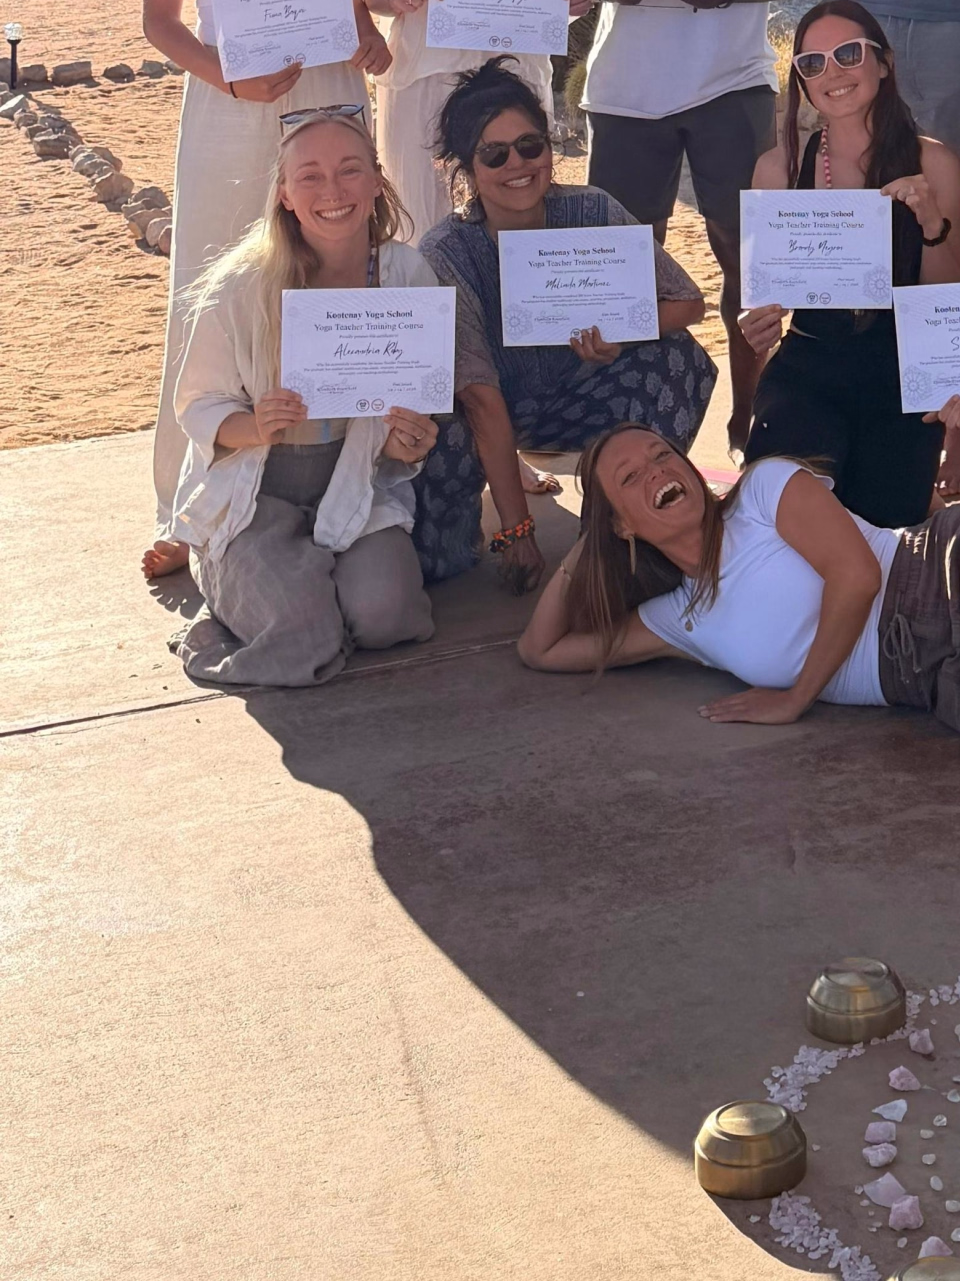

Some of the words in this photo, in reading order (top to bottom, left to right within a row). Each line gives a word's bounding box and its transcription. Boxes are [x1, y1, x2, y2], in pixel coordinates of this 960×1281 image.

[778, 211, 809, 219] Kootenay
[326, 311, 362, 320] Kootenay
[365, 311, 384, 319] Yoga
[387, 310, 412, 318] School
[315, 324, 332, 332] Yoga
[335, 323, 362, 331] Teacher
[365, 323, 396, 331] Training
